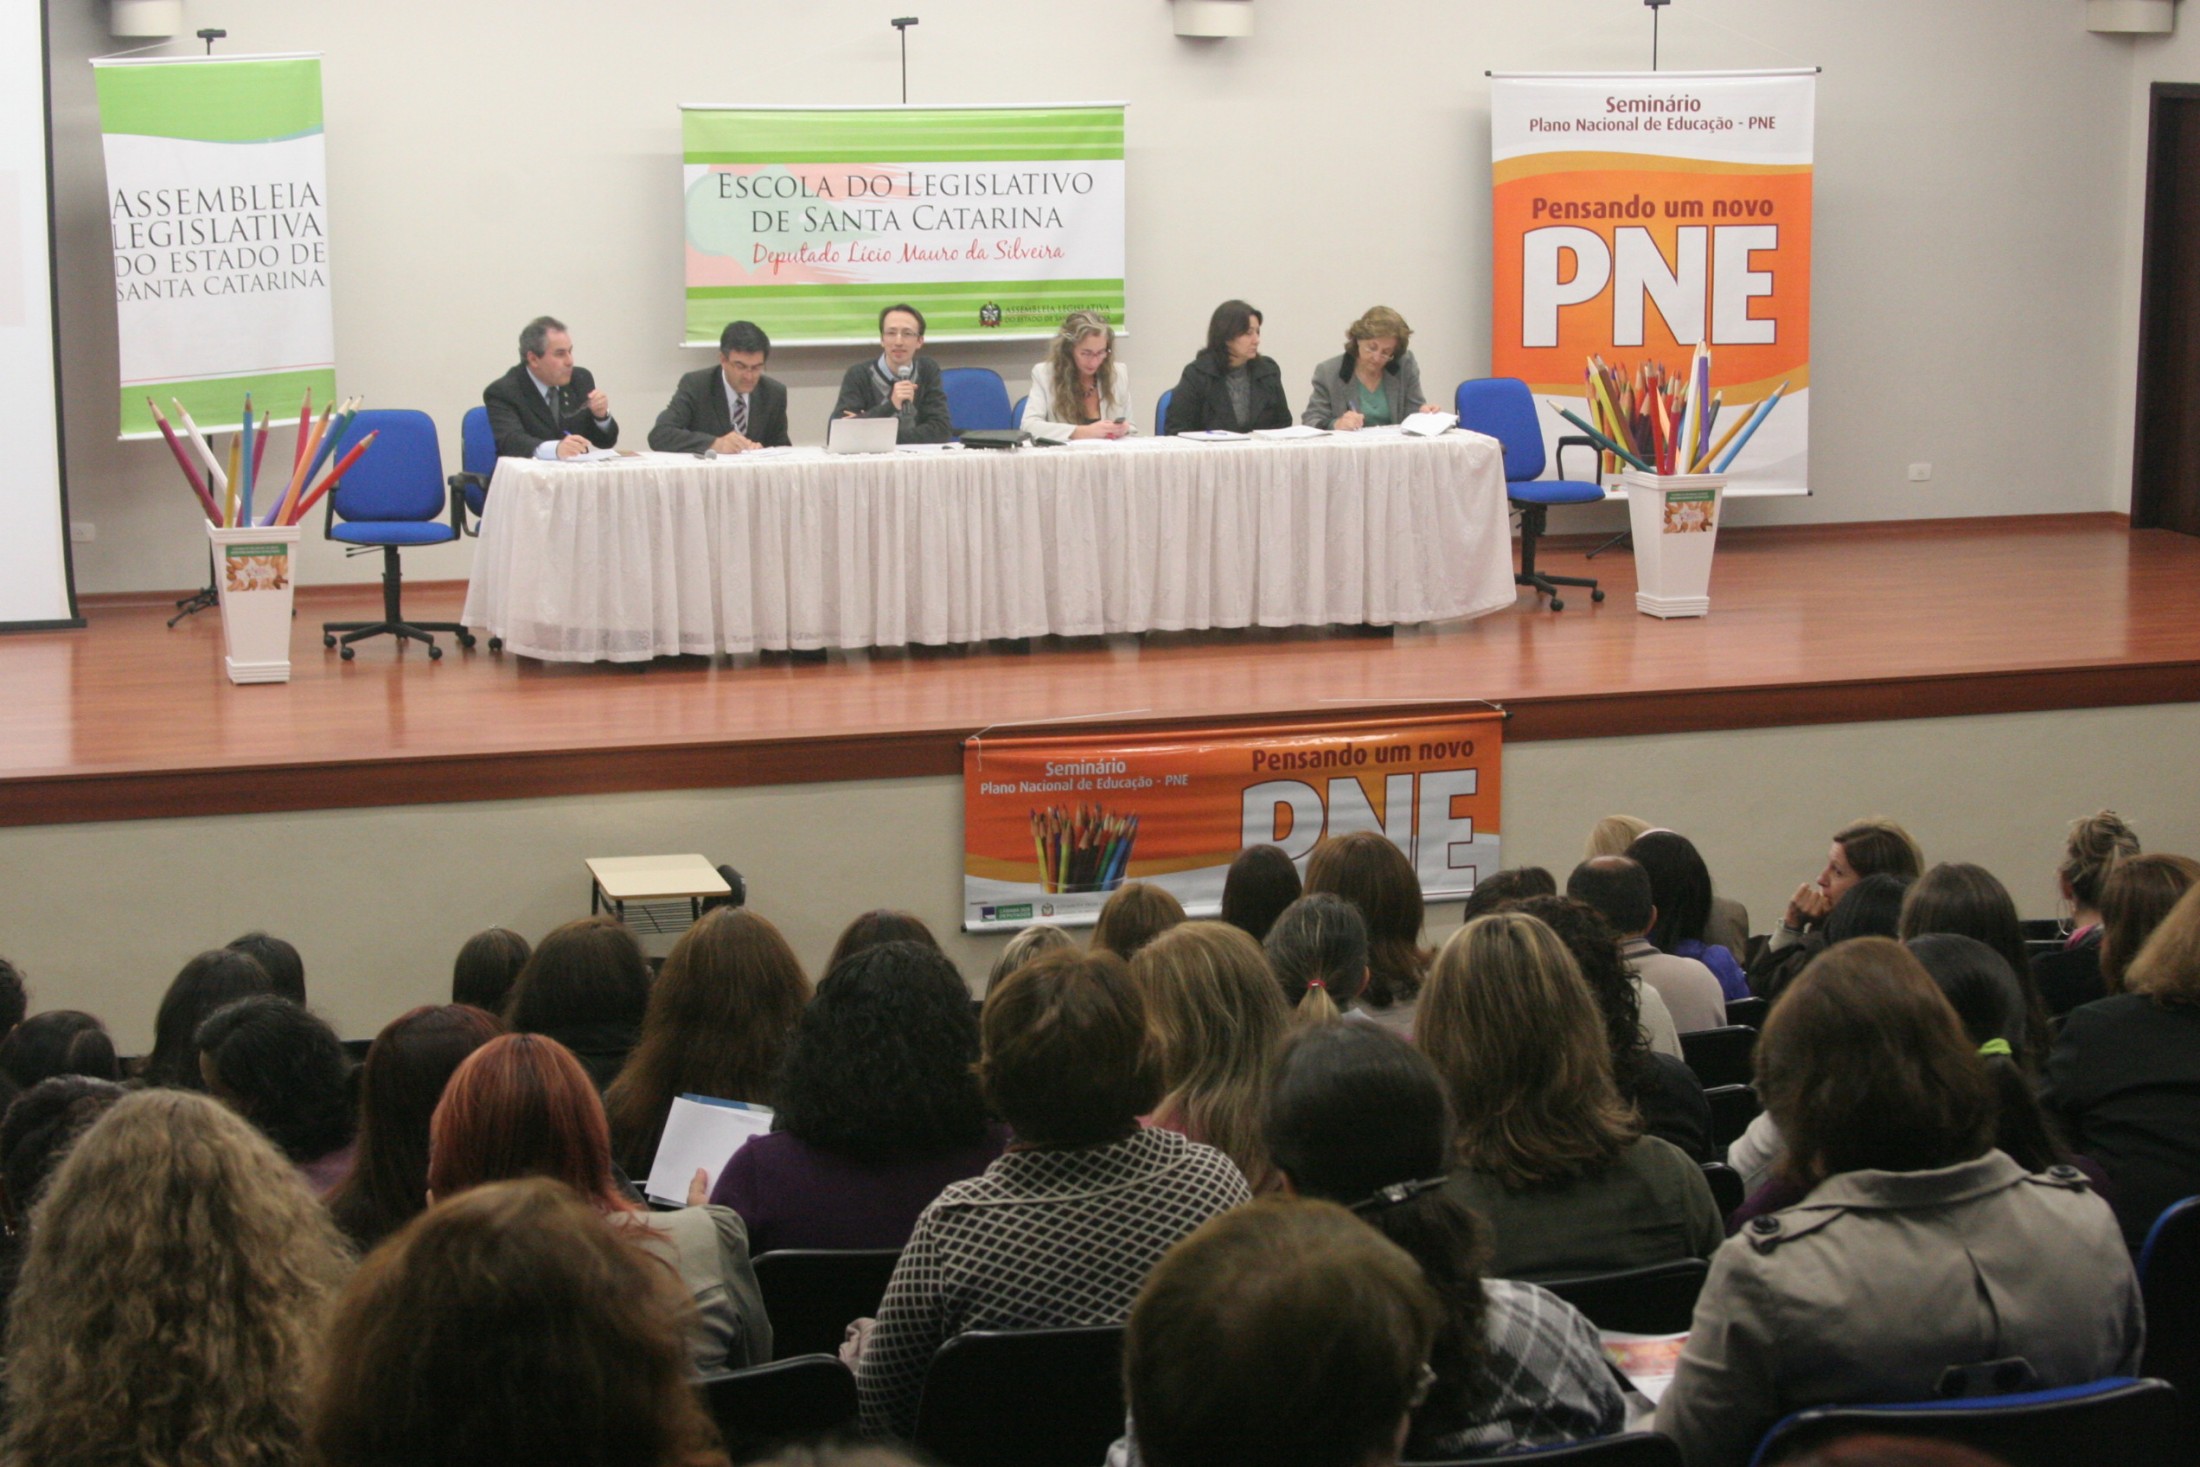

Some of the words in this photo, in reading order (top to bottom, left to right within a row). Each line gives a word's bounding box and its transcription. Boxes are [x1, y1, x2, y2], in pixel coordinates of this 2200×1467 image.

[1605, 95, 1701, 113] Seminário
[1529, 118, 1571, 132] Plano
[1575, 117, 1639, 132] Nacional
[1643, 117, 1662, 131] de
[1666, 117, 1734, 133] Educação
[1748, 116, 1776, 130] PNE
[112, 181, 321, 219] ASSEMBLEIA
[718, 172, 834, 199] ESCOLA
[907, 171, 1094, 197] LEGISLATIVO
[803, 206, 902, 233] SANTA
[912, 204, 1064, 231] CATARINA
[1531, 194, 1656, 219] Pensando
[1664, 198, 1704, 218] um
[1712, 198, 1774, 217] novo
[112, 211, 323, 250] LEGISLATIVA
[115, 253, 156, 277] DO
[170, 245, 279, 274] ESTADO
[291, 242, 326, 265] DE
[753, 241, 840, 275] Deputado
[847, 241, 891, 263] Lício
[896, 242, 959, 264] Mauro
[965, 238, 989, 260] da
[994, 237, 1065, 260] Silveira
[116, 278, 195, 302] SANTA
[203, 268, 326, 296] CATARINA
[1521, 223, 1779, 348] PNE
[1045, 758, 1126, 777] Seminário
[1252, 743, 1367, 772] Pensando
[1375, 744, 1411, 763] um
[1419, 740, 1474, 761] novo
[980, 782, 1016, 795] Plano
[1019, 778, 1074, 793] Nacional
[1077, 777, 1093, 790] de
[1096, 775, 1153, 791] Educação
[1165, 774, 1189, 787] PNE
[1240, 767, 1478, 897] PNE
